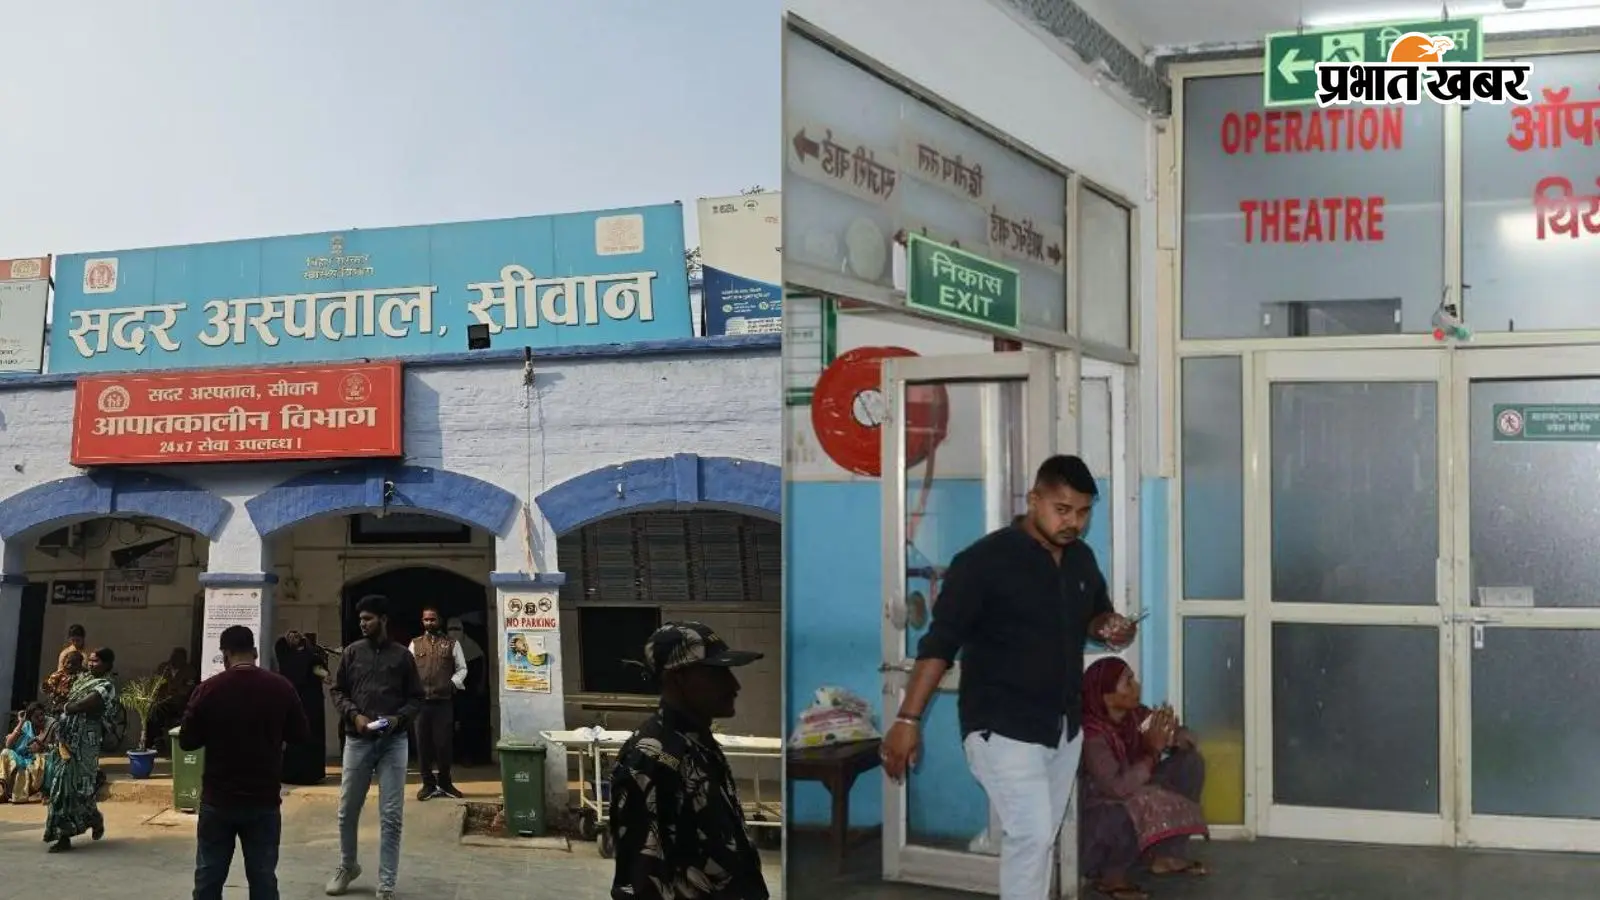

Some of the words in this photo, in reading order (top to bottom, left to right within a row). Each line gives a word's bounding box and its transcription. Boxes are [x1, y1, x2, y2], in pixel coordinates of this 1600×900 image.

[1220, 107, 1404, 154] OPERATION
[1506, 86, 1600, 152] ऑप
[1239, 196, 1385, 243] THEATRE
[930, 251, 1003, 297] निकास
[68, 302, 188, 358] सदर
[198, 285, 448, 347] अस्पताल,
[467, 263, 658, 336] सीवान
[938, 285, 994, 318] EXIT
[148, 387, 184, 402] सदर
[189, 384, 262, 401] अस्पताल,
[268, 379, 319, 397] सीवान
[91, 405, 271, 436] आपातकालीन
[280, 403, 378, 430] विभाग
[198, 437, 229, 452] सेवा
[506, 617, 519, 628] NO
[521, 616, 557, 628] PARKING
